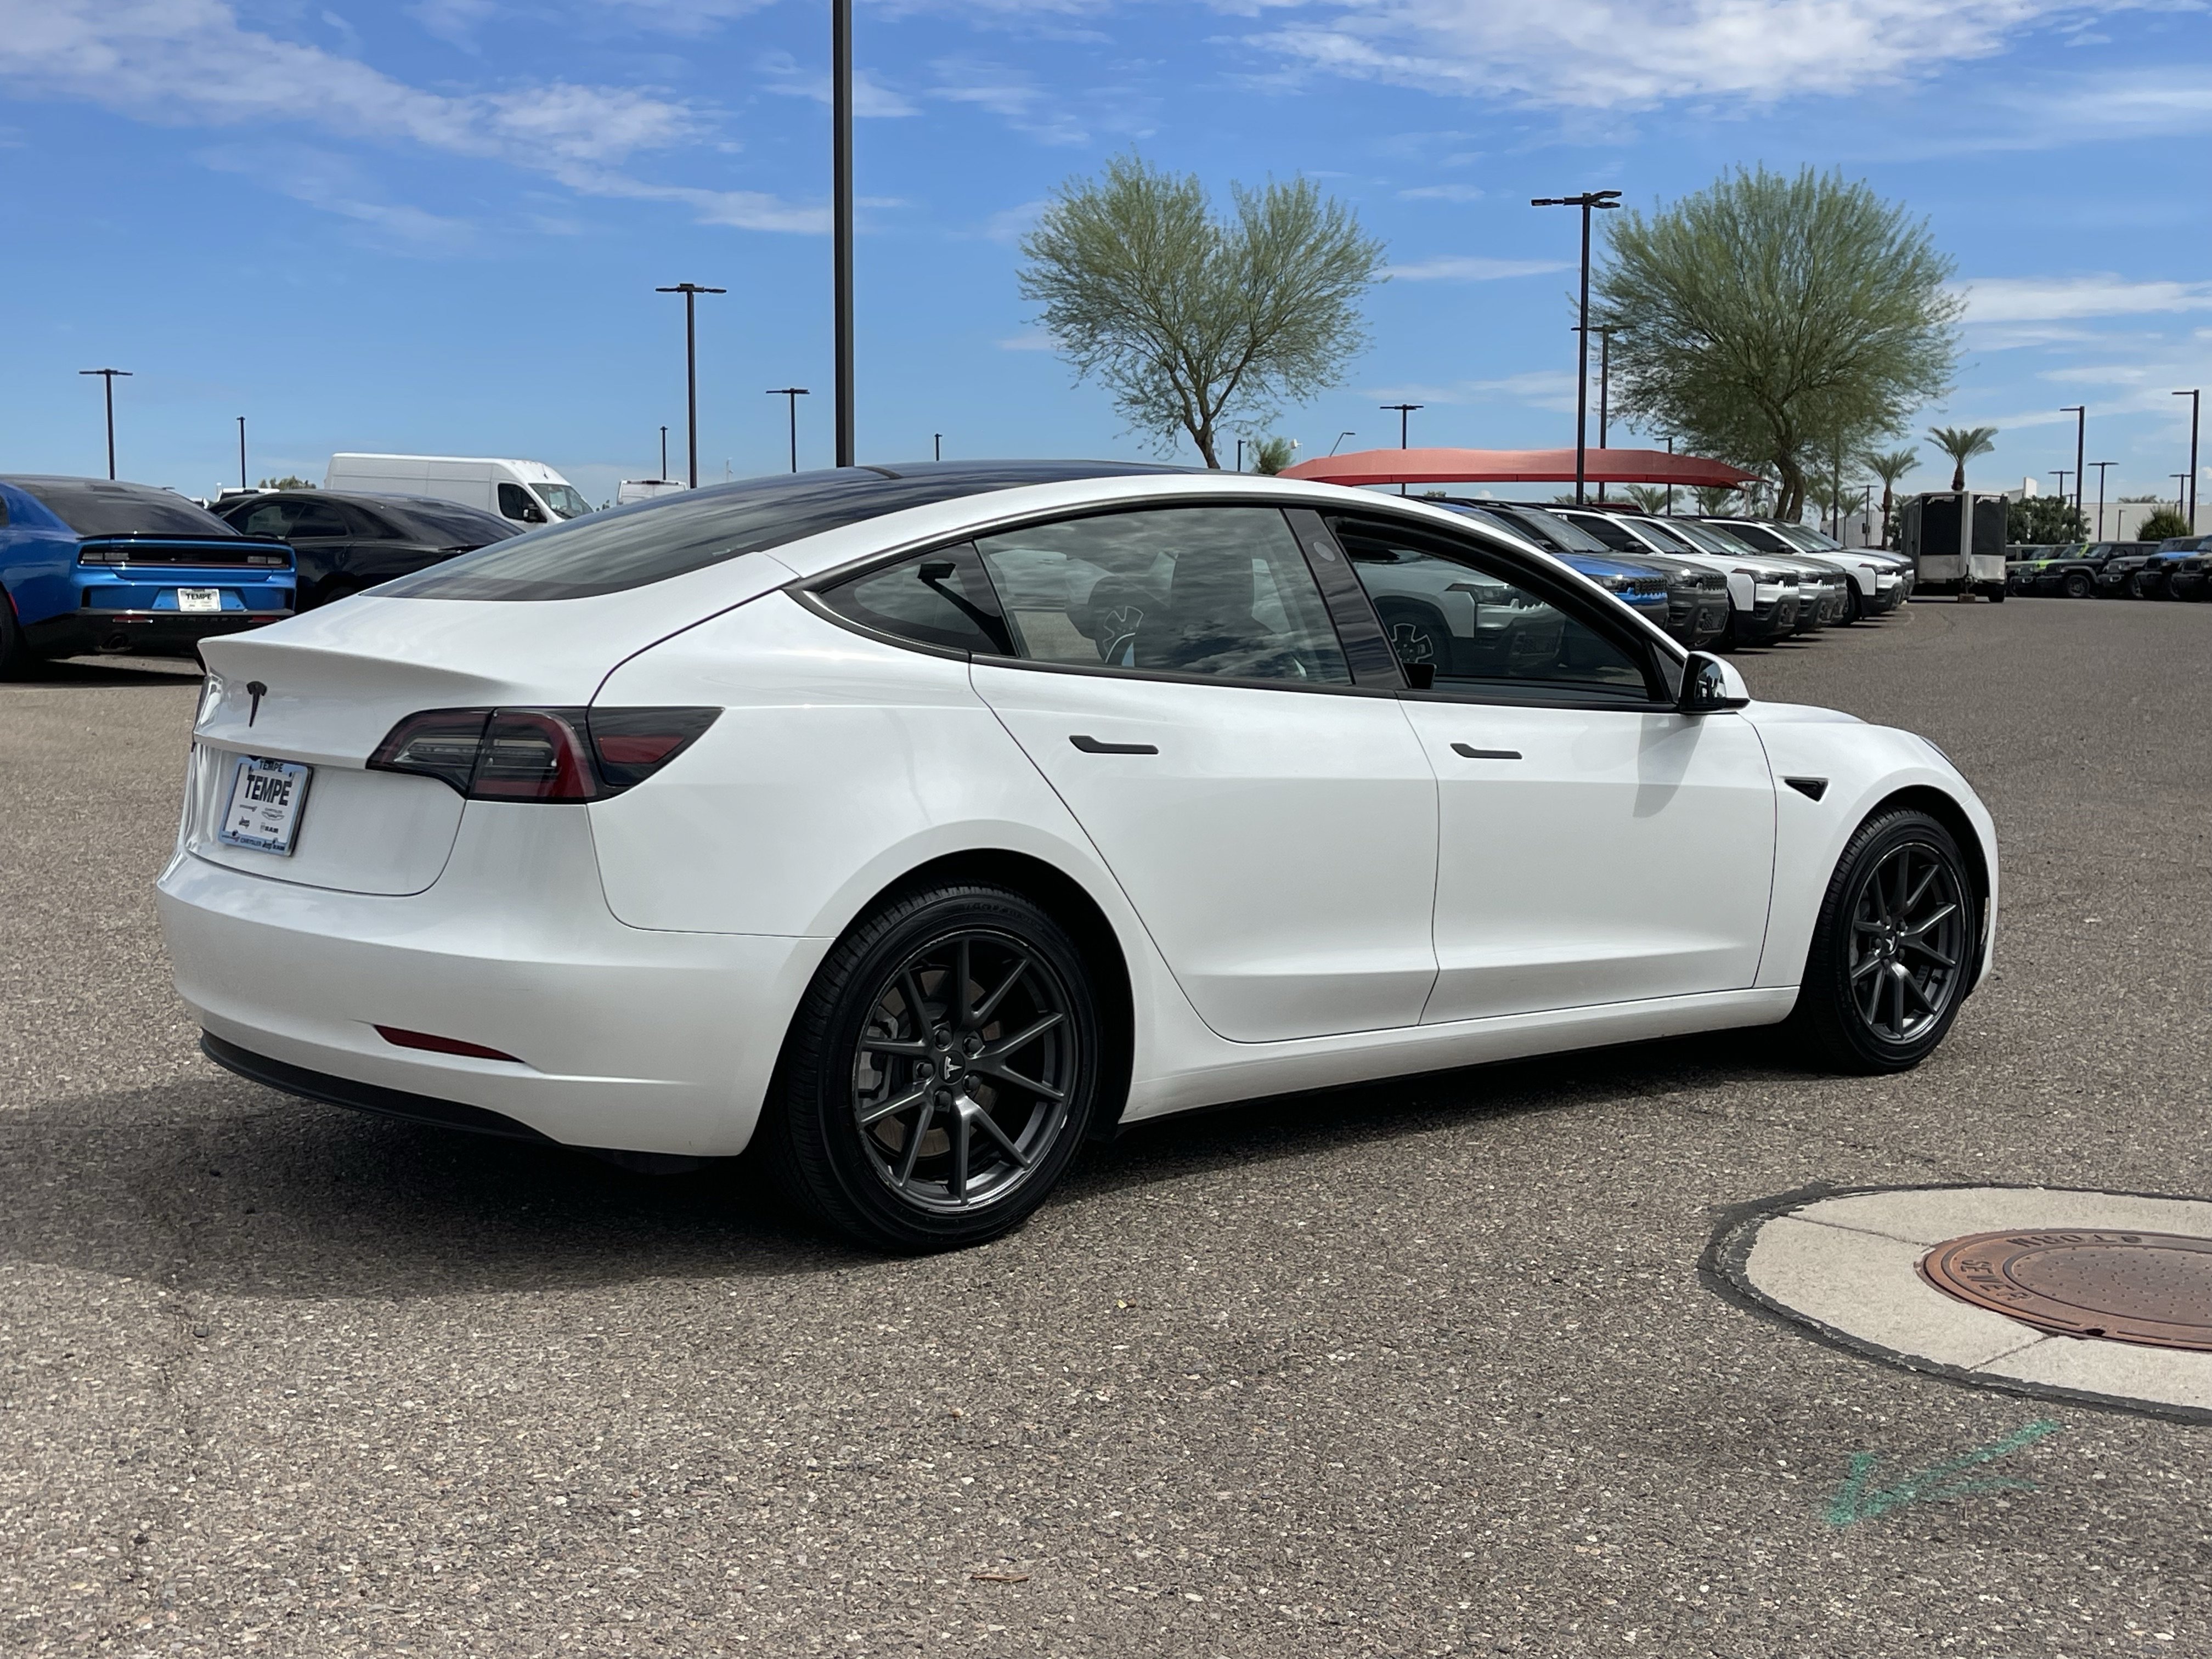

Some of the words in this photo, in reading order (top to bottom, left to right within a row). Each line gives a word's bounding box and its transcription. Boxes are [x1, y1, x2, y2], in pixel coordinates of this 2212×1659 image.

[259, 760, 284, 772] TEMPE
[245, 774, 292, 806] TEMPE
[1960, 1259, 2032, 1301] SEWER
